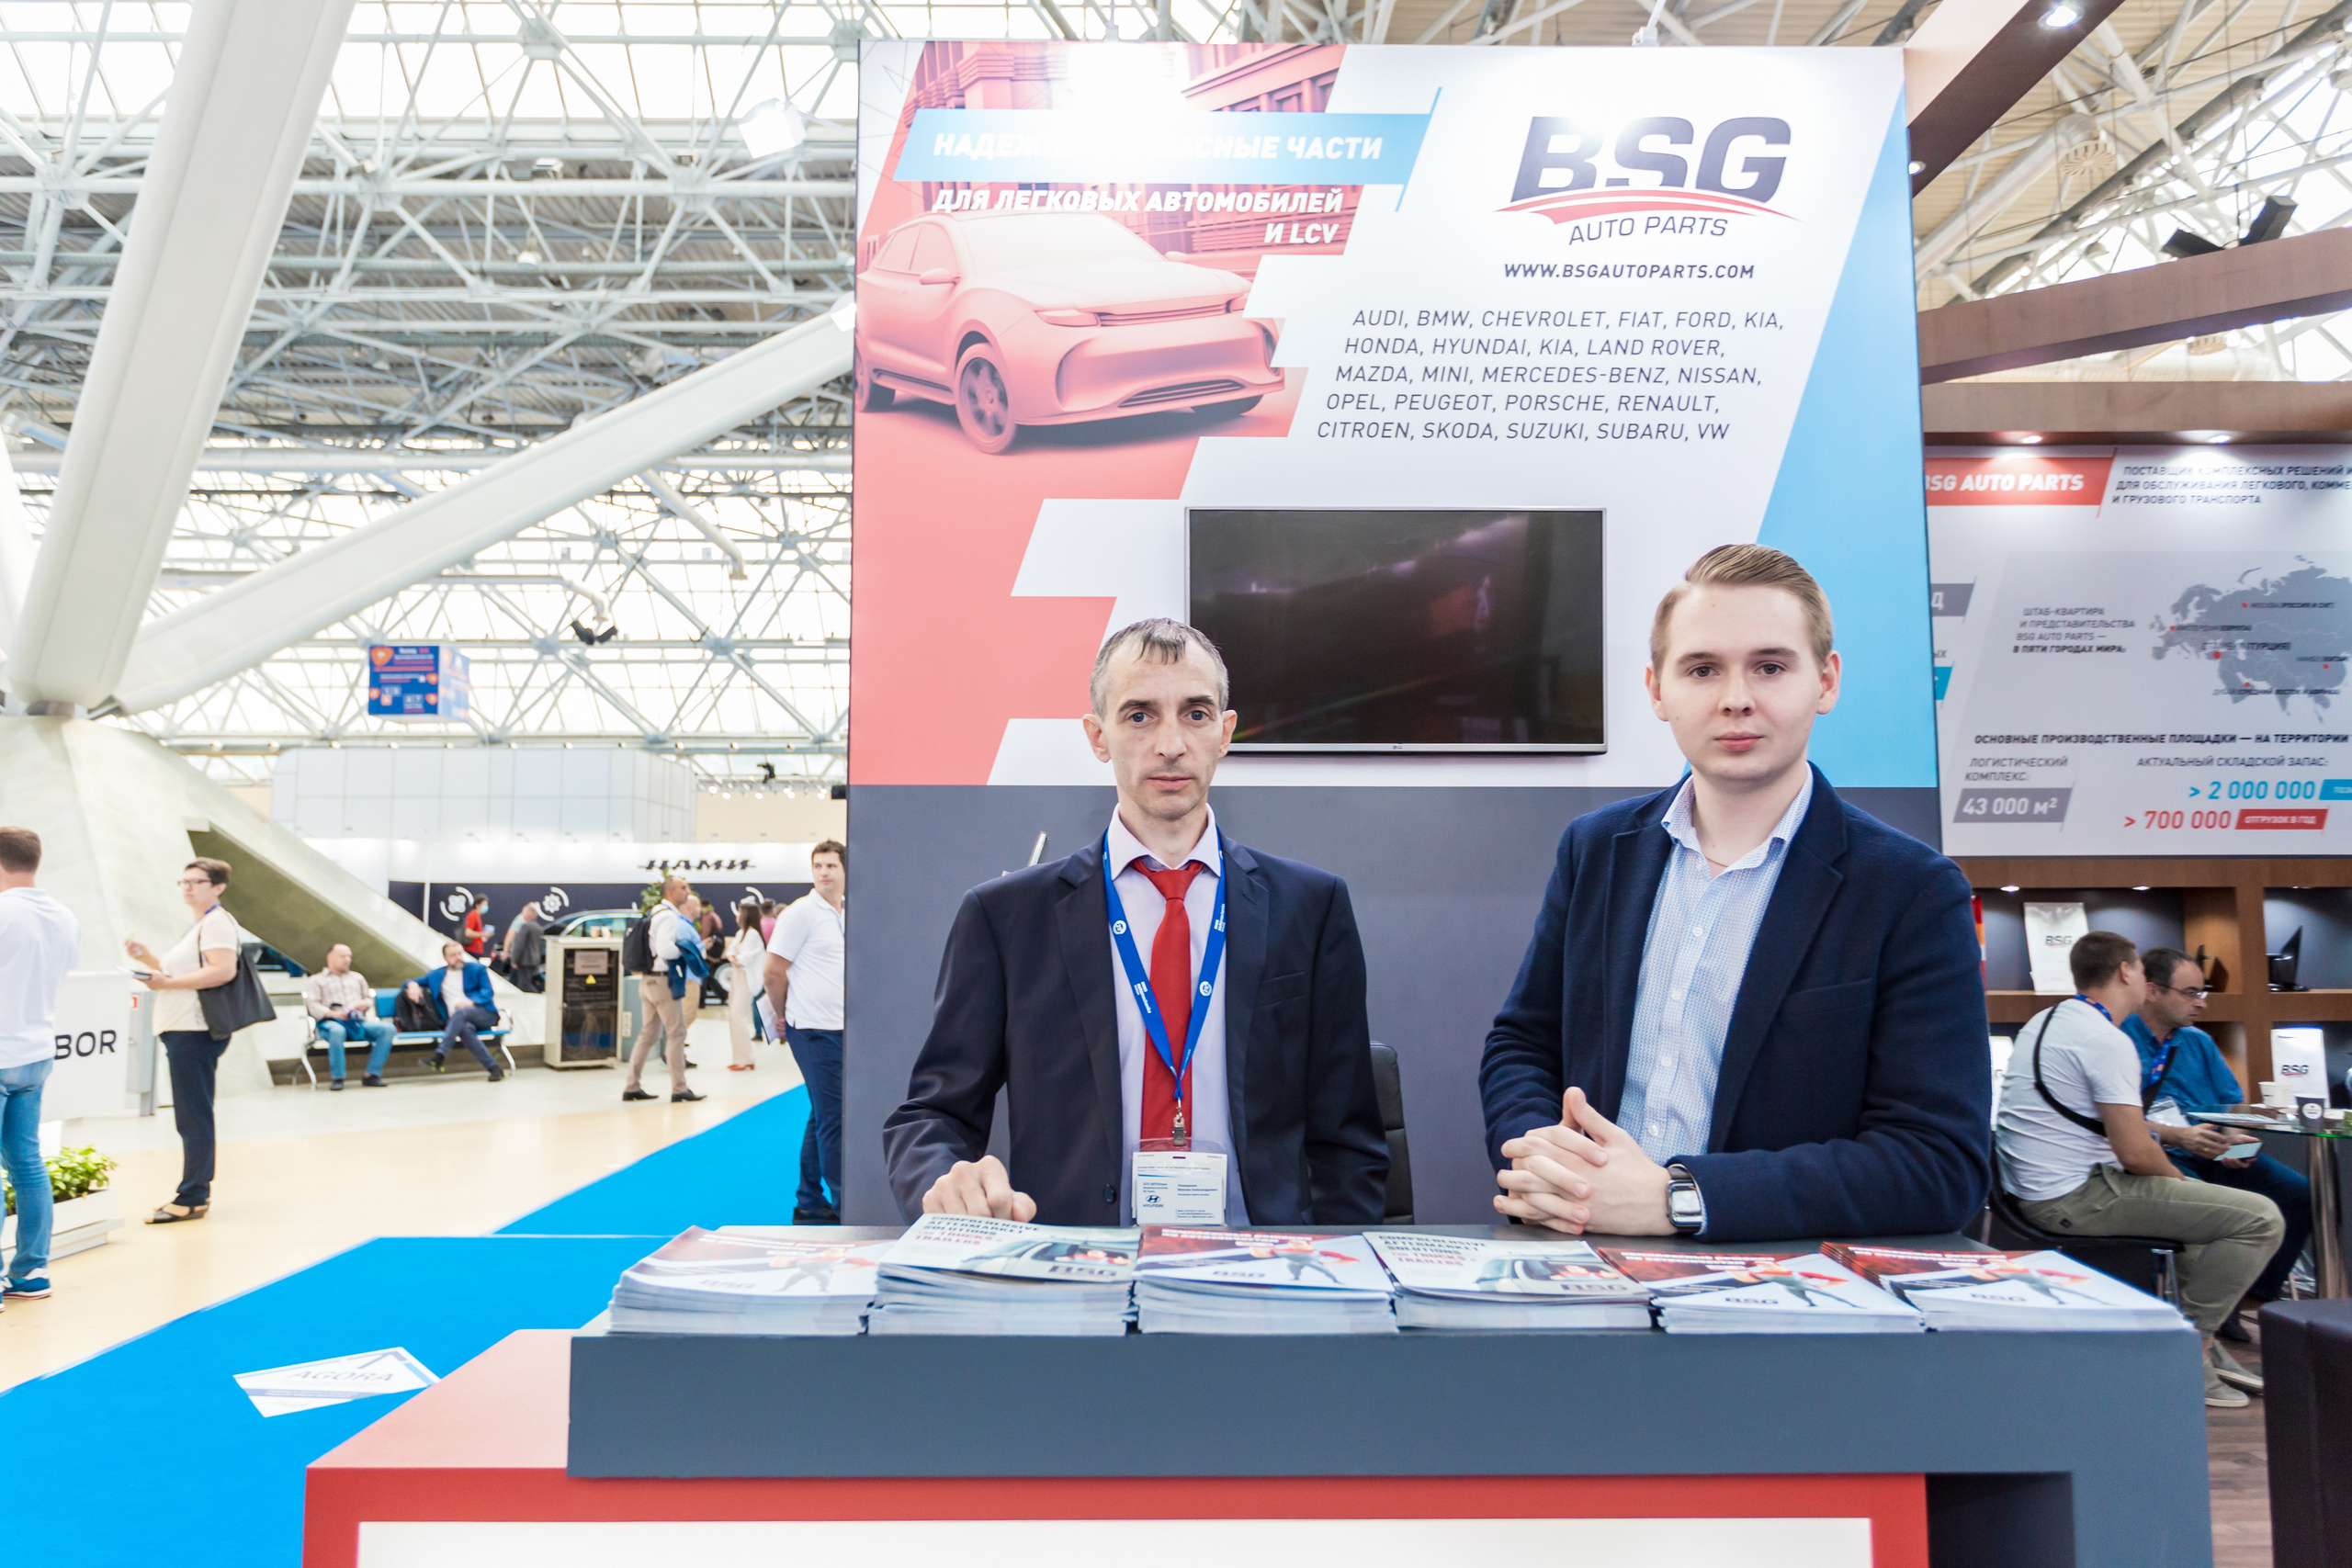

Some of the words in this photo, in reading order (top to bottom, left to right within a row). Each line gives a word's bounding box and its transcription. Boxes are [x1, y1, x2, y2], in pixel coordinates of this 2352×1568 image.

[933, 133, 1108, 161] НАДЕЖН
[1115, 135, 1281, 161] АСНЫЕ
[1288, 137, 1384, 161] ЧАСТИ
[1510, 116, 1792, 204] BSG
[932, 188, 989, 213] ДЛЯ
[993, 189, 1142, 213] ЛЕГКОВЫХ
[1144, 187, 1345, 214] АВТОМОБИЛЕЙ
[1264, 223, 1286, 244] И
[1289, 223, 1340, 244] LCV
[1568, 217, 1634, 245] AUTO
[1644, 216, 1728, 237] PARTS
[1504, 264, 1755, 279] WWW.BSGAUTOPARTS.COM
[1352, 310, 1409, 330] AUDI,
[1417, 310, 1474, 330] BMW,
[1481, 310, 1611, 330] CHEVROLET,
[1618, 310, 1669, 330] FIAT,
[1675, 310, 1736, 331] FORD,
[1744, 310, 1784, 331] KIA,
[1344, 337, 1425, 357] HONDA,
[1431, 337, 1532, 357] HYUNDAI,
[1539, 338, 1580, 357] KIA,
[1587, 338, 1645, 355] LAND
[1651, 338, 1725, 358] ROVER,
[1335, 366, 1415, 386] MAZDA,
[1421, 366, 1475, 386] MINI,
[1481, 366, 1670, 386] MERCEDES-BENZ,
[1678, 367, 1762, 387] NISSAN,
[1326, 394, 1386, 413] OPEL,
[1394, 394, 1498, 413] PEUGEOT,
[1504, 394, 1611, 414] PORSCHE,
[1617, 394, 1721, 414] RENAULT,
[1317, 422, 1417, 442] CITROEN,
[1422, 422, 1500, 442] SKODA,
[1506, 422, 1590, 442] SUZUKI,
[1596, 423, 1690, 442] SUBARU,
[1698, 423, 1730, 440] VW
[2123, 466, 2194, 477] ПОСТАВЩИК
[2287, 464, 2345, 476] РЕШЕНИЙ
[1959, 474, 2017, 491] AUTO
[2018, 474, 2085, 491] PARTS
[2116, 480, 2140, 491] ДЛЯ
[2143, 480, 2238, 491] ОБСЛУЖИВАНИЯ
[2240, 480, 2309, 491] ЛЕГКОВОГО,
[2112, 495, 2120, 504] И
[2122, 494, 2186, 504] ГРУЗОВОГО
[2189, 494, 2262, 504] ТРАНСПОРТА
[2023, 607, 2105, 616] ШТАБ-КВАРТИРА
[2019, 620, 2028, 628] И
[2029, 620, 2136, 629] ПРЕДСТАВИТЕЛЬСТВА
[2016, 632, 2036, 641] BSG
[2038, 632, 2063, 641] AUTO
[2064, 632, 2095, 641] PARTS
[2012, 645, 2019, 653] В
[2021, 645, 2048, 653] ПЯТИ
[2050, 645, 2094, 654] ГОРОДАХ
[2096, 645, 2127, 653] МИРА:
[1974, 734, 2038, 744] ОСНОВНЫЕ
[2041, 734, 2166, 745] ПРОИЗВОДСТВЕННЫЕ
[2169, 734, 2237, 745] ПЛОЩАДКИ
[2255, 734, 2271, 744] НА
[2274, 734, 2349, 744] ТЕРРИТОРИИ
[1969, 755, 2069, 768] ЛОГИСТИЧЕСКИЙ
[2136, 755, 2215, 768] АКТУАЛЬНЫЙ
[2216, 755, 2286, 768] СКЛАДСКОЙ
[2288, 757, 2329, 767] ЗАПАС:
[1964, 772, 2030, 782] КОМПЛЕКС:
[2207, 781, 2222, 800] 2
[2227, 781, 2269, 800] 000
[2274, 781, 2316, 800] 000
[1962, 797, 1988, 816] 43
[1992, 797, 2030, 816] 000
[2144, 811, 2185, 829] 700
[2190, 811, 2233, 829] 000
[2044, 934, 2074, 945] BSG
[2281, 1064, 2310, 1075] BSG
[288, 1371, 395, 1382] AGORA
